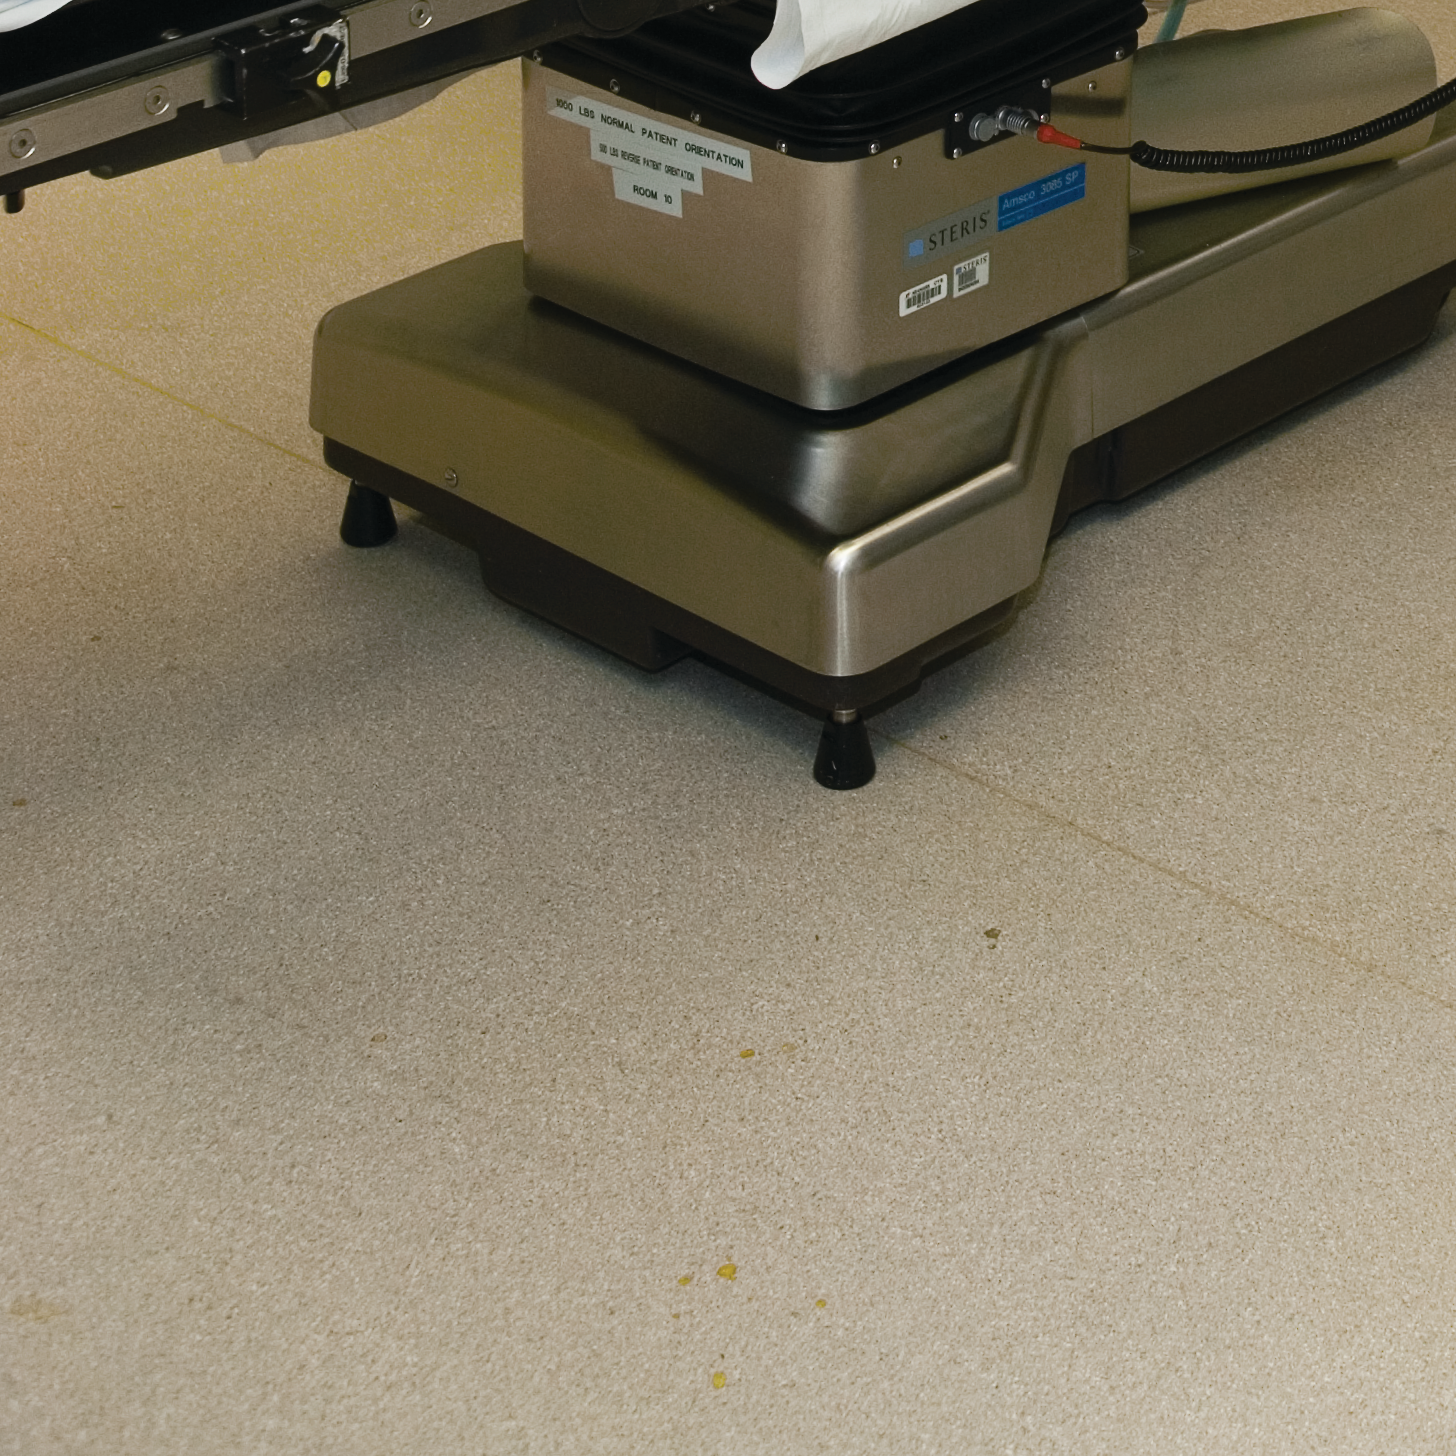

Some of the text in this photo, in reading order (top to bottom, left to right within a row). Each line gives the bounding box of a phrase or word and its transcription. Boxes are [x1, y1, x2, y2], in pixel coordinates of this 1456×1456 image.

[555, 97, 744, 170] 1000 LBS NORMAL PATIENT ORIENTATION
[609, 146, 619, 158] LBS
[620, 150, 641, 165] REVERSE
[643, 157, 662, 171] PATIENT
[664, 164, 695, 182] ORIENTATION
[633, 184, 673, 205] ROOM 10
[1002, 170, 1079, 211] Amsco 3085 SP
[928, 211, 989, 251] STERIS
[962, 254, 988, 271] STERIS
